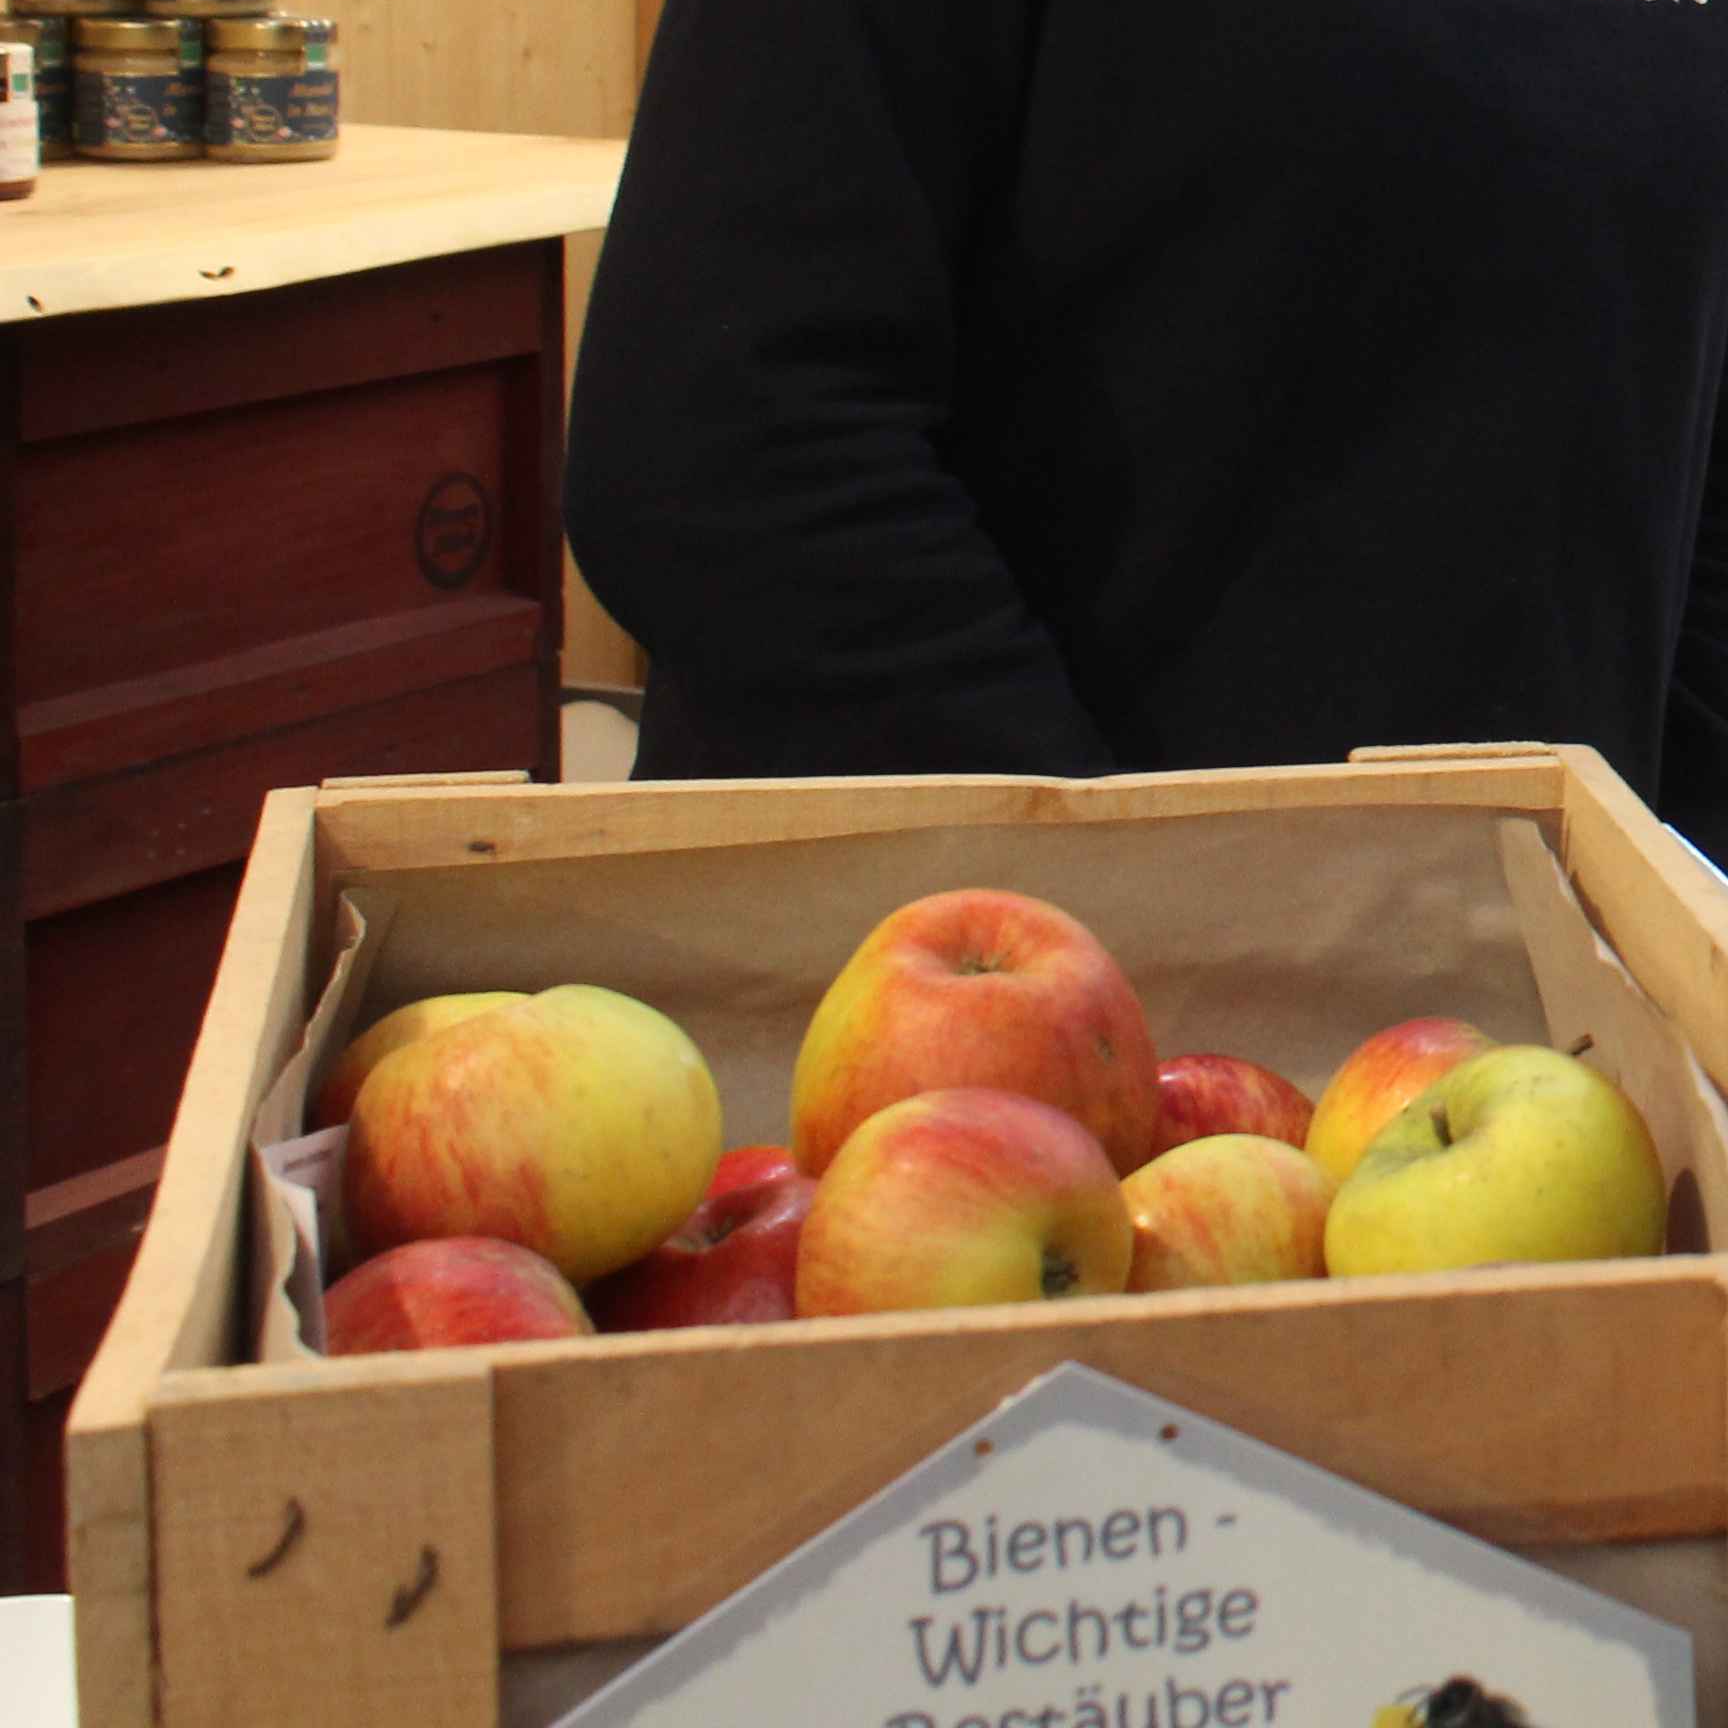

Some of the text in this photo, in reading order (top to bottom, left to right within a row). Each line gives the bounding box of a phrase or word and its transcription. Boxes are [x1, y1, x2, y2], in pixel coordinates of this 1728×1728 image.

[918, 1504, 1190, 1595] Bienen
[907, 1584, 1262, 1689] Wichtige
[883, 1674, 1293, 1728] äuber
